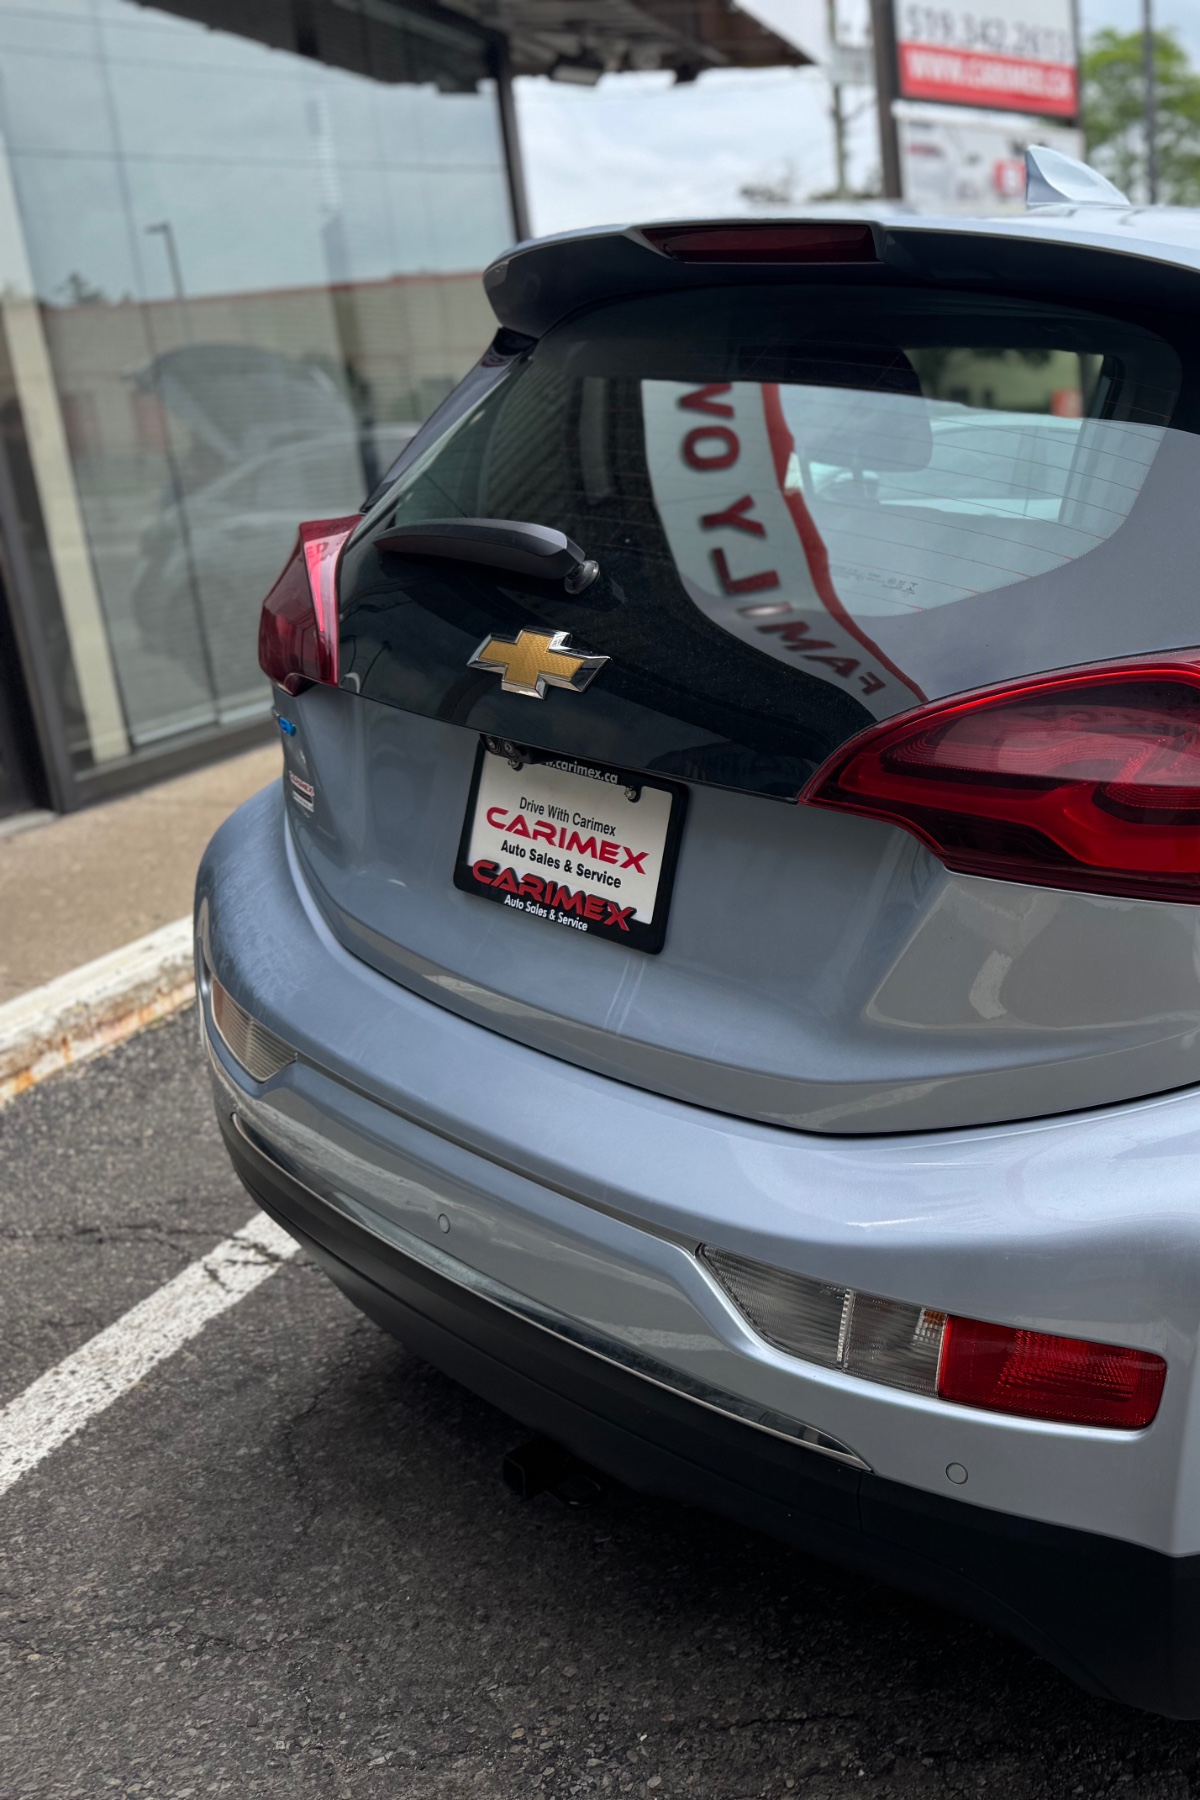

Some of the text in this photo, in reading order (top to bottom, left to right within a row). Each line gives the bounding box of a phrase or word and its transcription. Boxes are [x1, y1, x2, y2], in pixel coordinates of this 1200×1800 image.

[486, 806, 650, 875] CARIMEX
[519, 796, 617, 837] Drive With Carimex
[501, 839, 622, 889] Auto Sales & Service
[472, 859, 634, 932] CARIMEX
[504, 894, 589, 932] Auto Sales & Service
